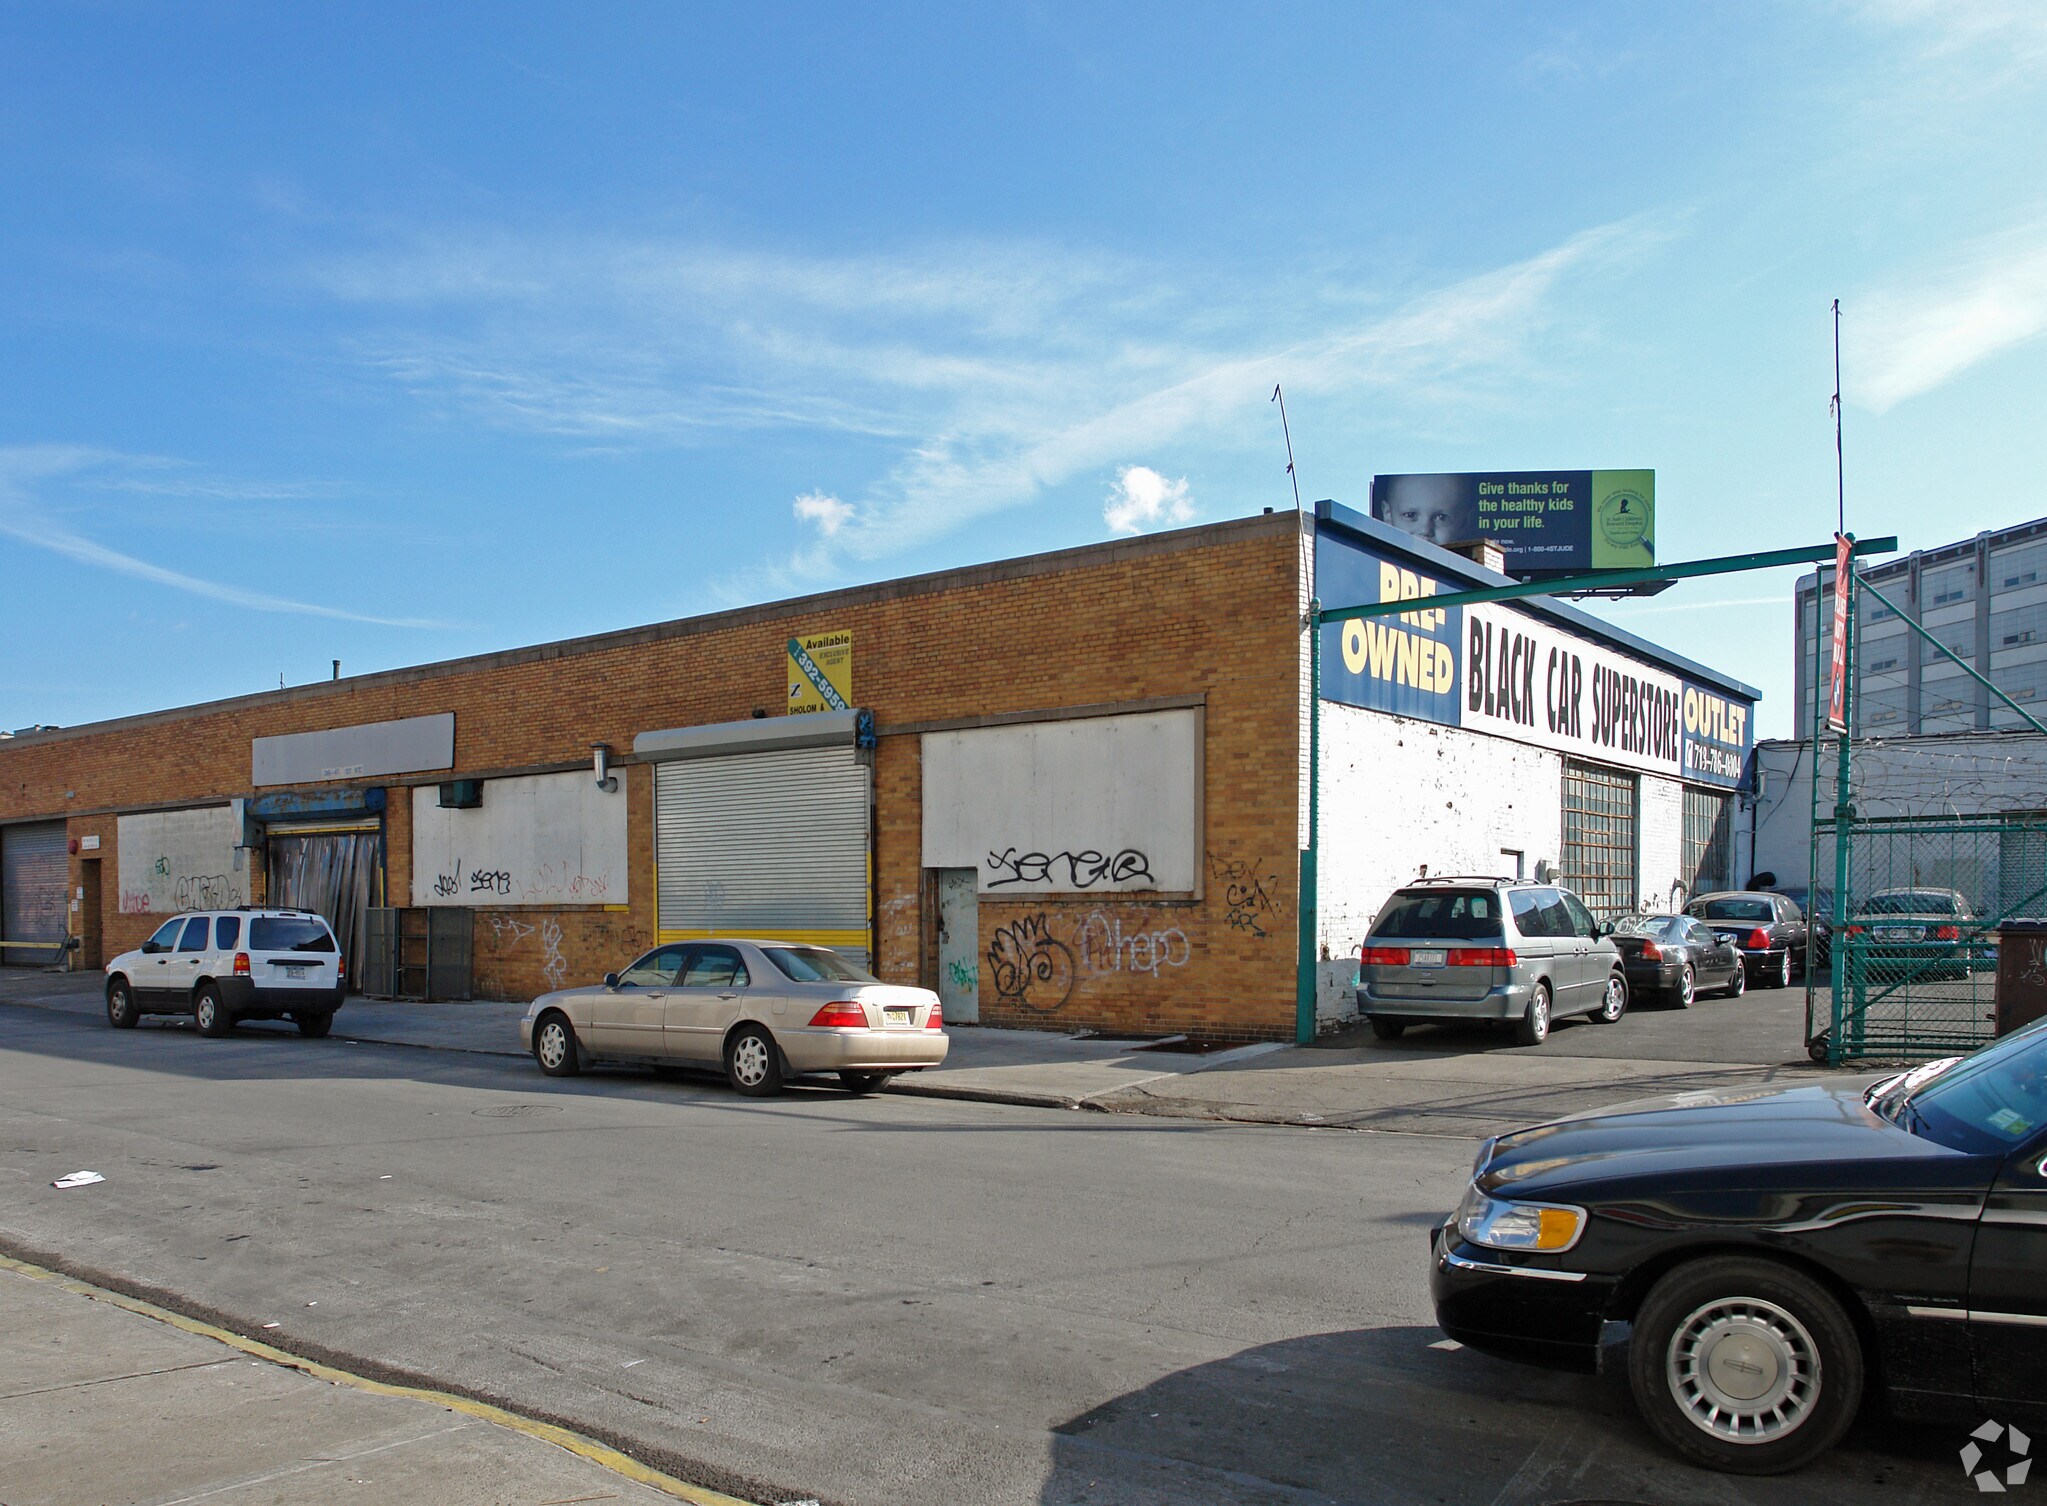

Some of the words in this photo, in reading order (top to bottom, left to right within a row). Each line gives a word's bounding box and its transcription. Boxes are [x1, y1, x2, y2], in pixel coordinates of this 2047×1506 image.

[1478, 482, 1504, 495] Give
[1508, 481, 1548, 494] thanks
[1552, 481, 1569, 494] for
[1478, 500, 1498, 512] the
[1502, 498, 1545, 514] healthy
[1548, 498, 1574, 511] kids
[1478, 517, 1490, 528] in
[1494, 518, 1520, 531] your
[1524, 516, 1544, 528] life.
[1380, 560, 1446, 632] PRE-
[806, 634, 850, 650] Available
[820, 648, 849, 659] EXCLUSIVE
[826, 657, 844, 666] AGENT
[1342, 618, 1454, 694] OWNED
[798, 652, 846, 711] 392-5959
[1469, 615, 1537, 728] BLACK
[1547, 646, 1582, 739] CAR
[1592, 662, 1679, 762] SUPERSTORE
[790, 704, 816, 715] SHOLOM
[1684, 688, 1746, 747] OUTLET
